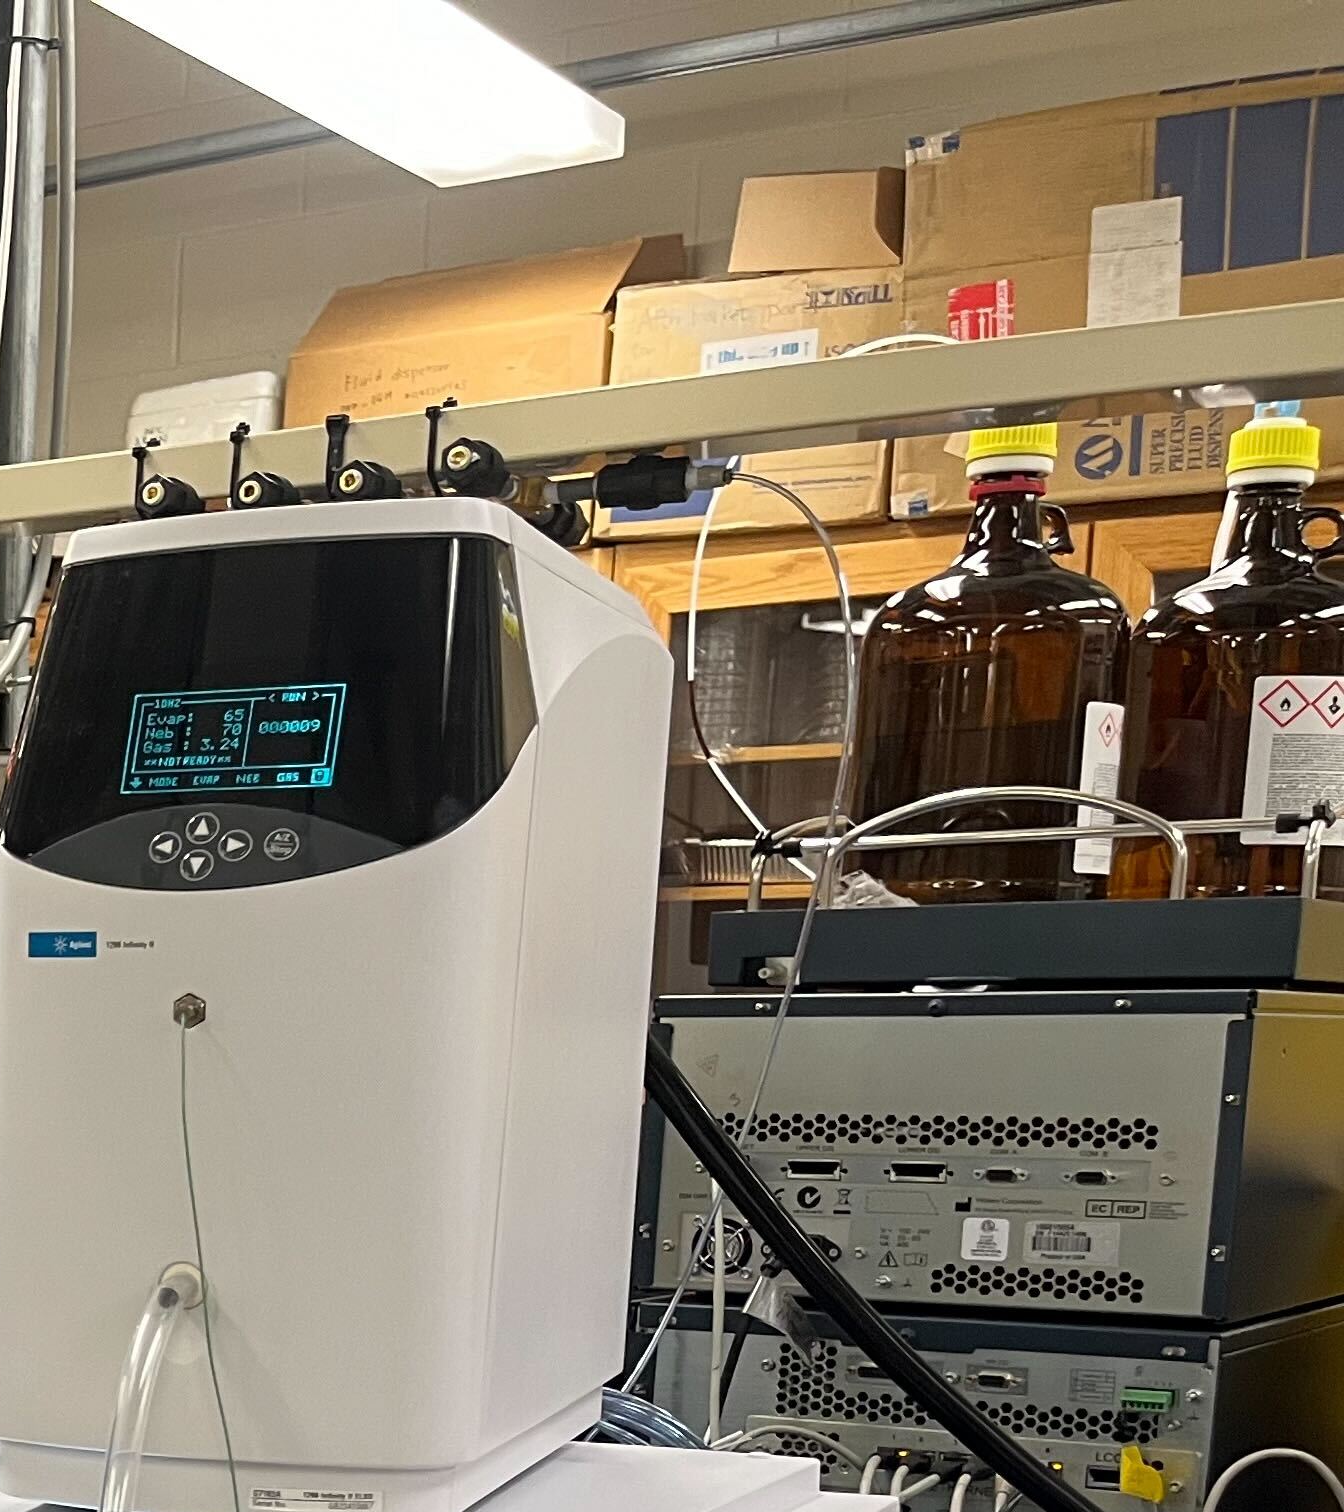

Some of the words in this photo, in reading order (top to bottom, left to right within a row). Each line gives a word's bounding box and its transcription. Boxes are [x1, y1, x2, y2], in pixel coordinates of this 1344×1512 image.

[1149, 427, 1167, 475] SUPER
[1186, 425, 1204, 471] FLUID
[223, 708, 245, 721] 65
[222, 722, 243, 736] 70
[142, 741, 173, 754] Gas
[1091, 1204, 1108, 1214] EC
[1116, 1205, 1141, 1215] REP
